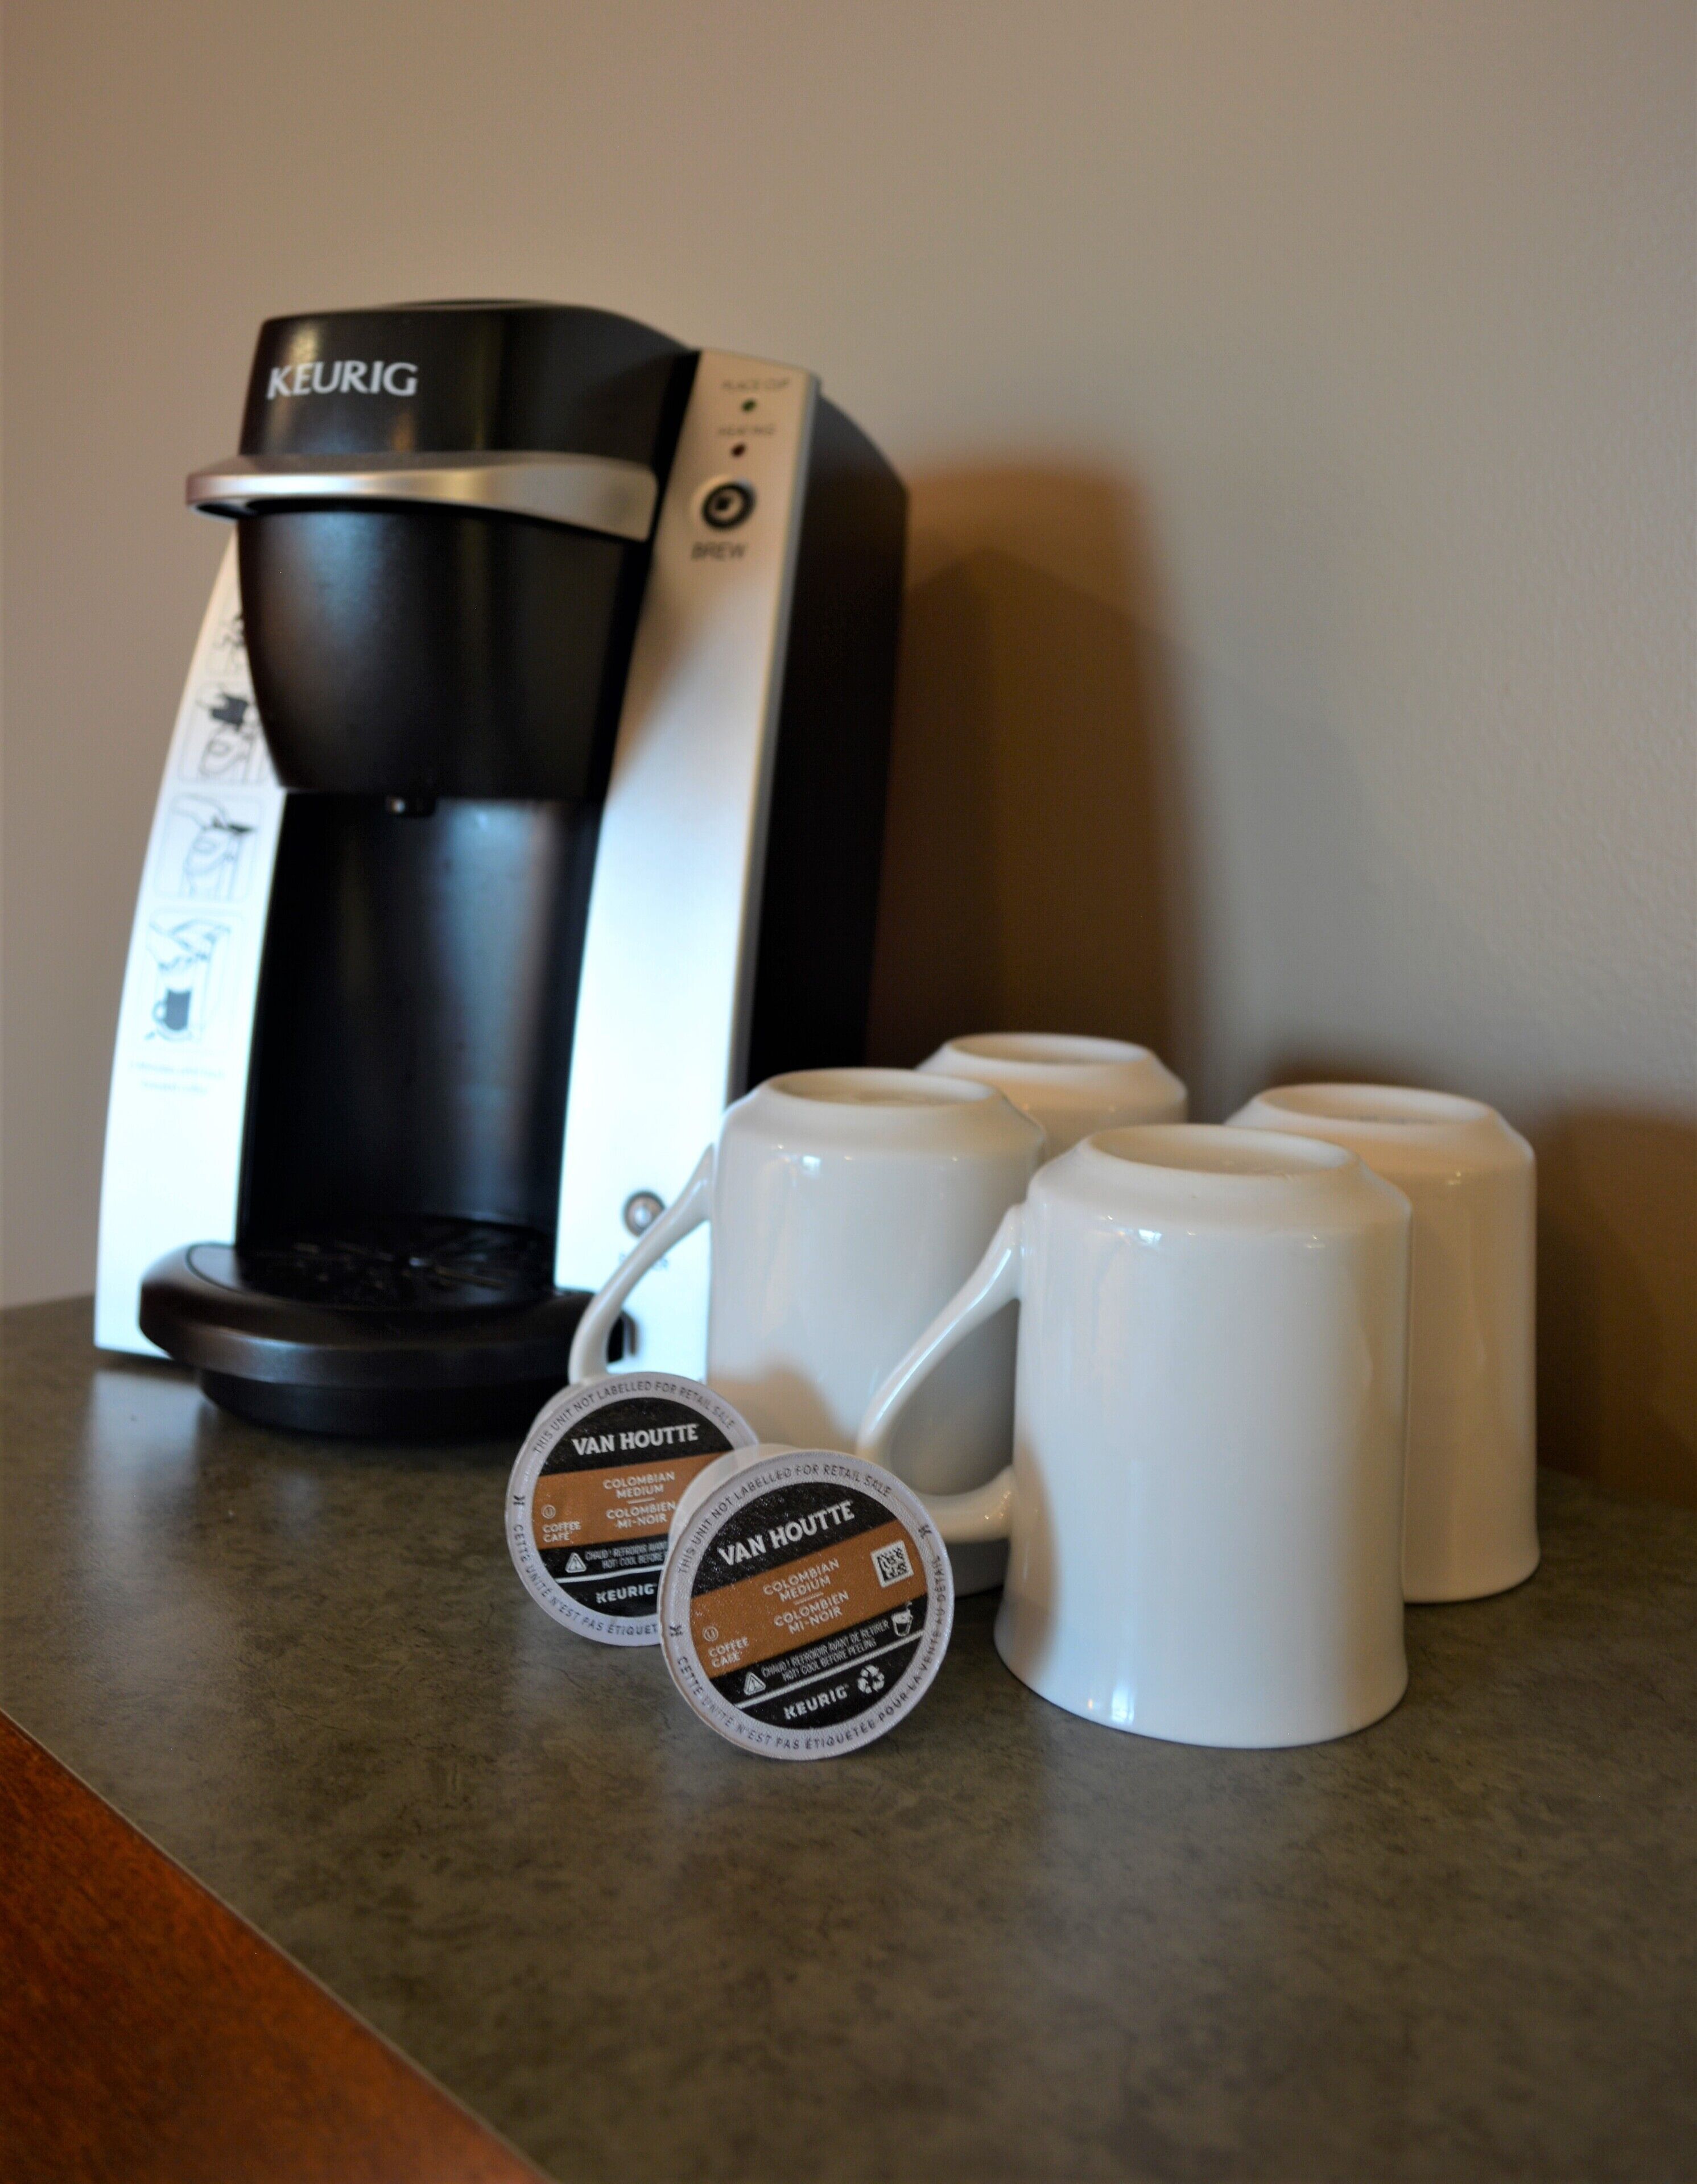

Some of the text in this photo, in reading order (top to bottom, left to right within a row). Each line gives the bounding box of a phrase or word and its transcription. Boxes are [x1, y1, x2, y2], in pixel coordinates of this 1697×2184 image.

[267, 361, 418, 399] KEURIG
[691, 541, 749, 561] BREW
[533, 1430, 554, 1454] THIS
[551, 1408, 573, 1431] UNIT
[573, 1393, 595, 1412] NOT
[597, 1381, 652, 1400] LABELLED
[655, 1381, 676, 1392] FOR
[571, 1424, 699, 1456] VAN HOUTTE
[603, 1471, 675, 1490] COLOMBIAN
[616, 1484, 664, 1499] MEDIUM
[606, 1501, 676, 1519] COLOMBIEN
[617, 1513, 667, 1529] MI-NOIR
[678, 1546, 695, 1574] THIS
[691, 1518, 713, 1545] UNIT
[711, 1496, 733, 1520] NOT
[733, 1467, 792, 1500] LABELLED
[796, 1464, 819, 1476] FOR
[823, 1464, 861, 1483] RETAIL
[542, 1520, 581, 1533] COFFEE
[717, 1500, 855, 1566] VAN HOUTTE
[762, 1558, 840, 1595] COLOMBIAN
[779, 1575, 831, 1602] MEDIUM
[596, 1583, 655, 1604] KEURIG
[774, 1590, 849, 1627] COLOMBIEN
[787, 1606, 843, 1634] MI-NOIR
[581, 1616, 604, 1632] PAS
[607, 1621, 658, 1636] ÉTIQUET
[709, 1636, 749, 1657] COFFEE
[827, 1636, 850, 1652] AVANT
[849, 1631, 861, 1643] DE
[799, 1660, 820, 1675] COOL
[819, 1649, 848, 1668] BEFORE
[775, 1737, 800, 1750] PAS
[878, 1691, 909, 1723] POUR
[906, 1675, 922, 1691] LA
[918, 1631, 942, 1672] VENTE
[783, 1685, 848, 1720] KEURIG
